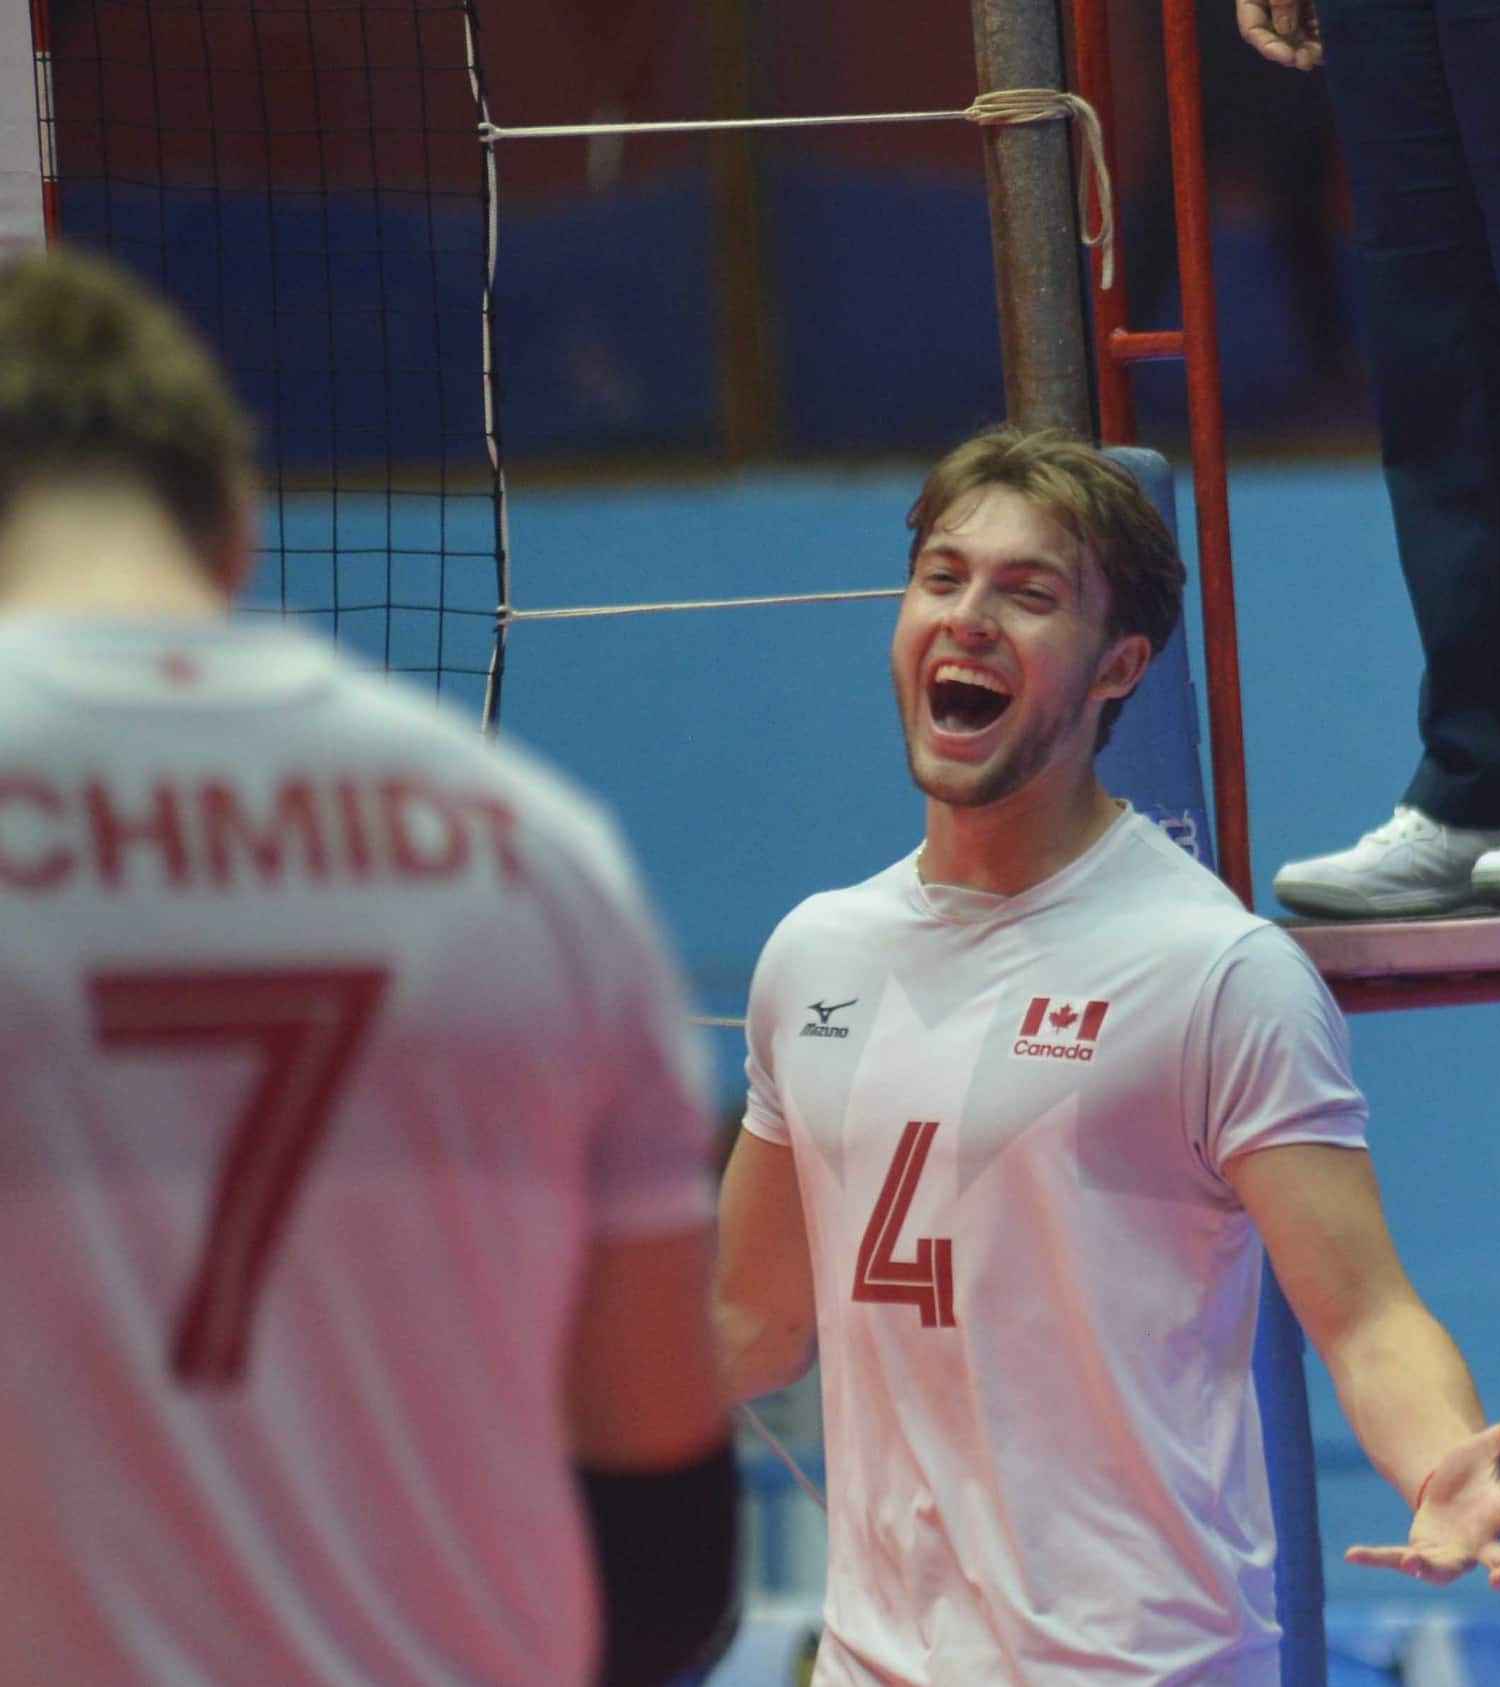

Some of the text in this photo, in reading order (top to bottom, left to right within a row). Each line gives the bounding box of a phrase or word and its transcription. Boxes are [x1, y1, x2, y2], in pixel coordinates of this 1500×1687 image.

[799, 1023, 848, 1038] Mizuno
[1013, 1039, 1094, 1061] Canada
[84, 964, 394, 1392] 7
[852, 1121, 957, 1328] 4
